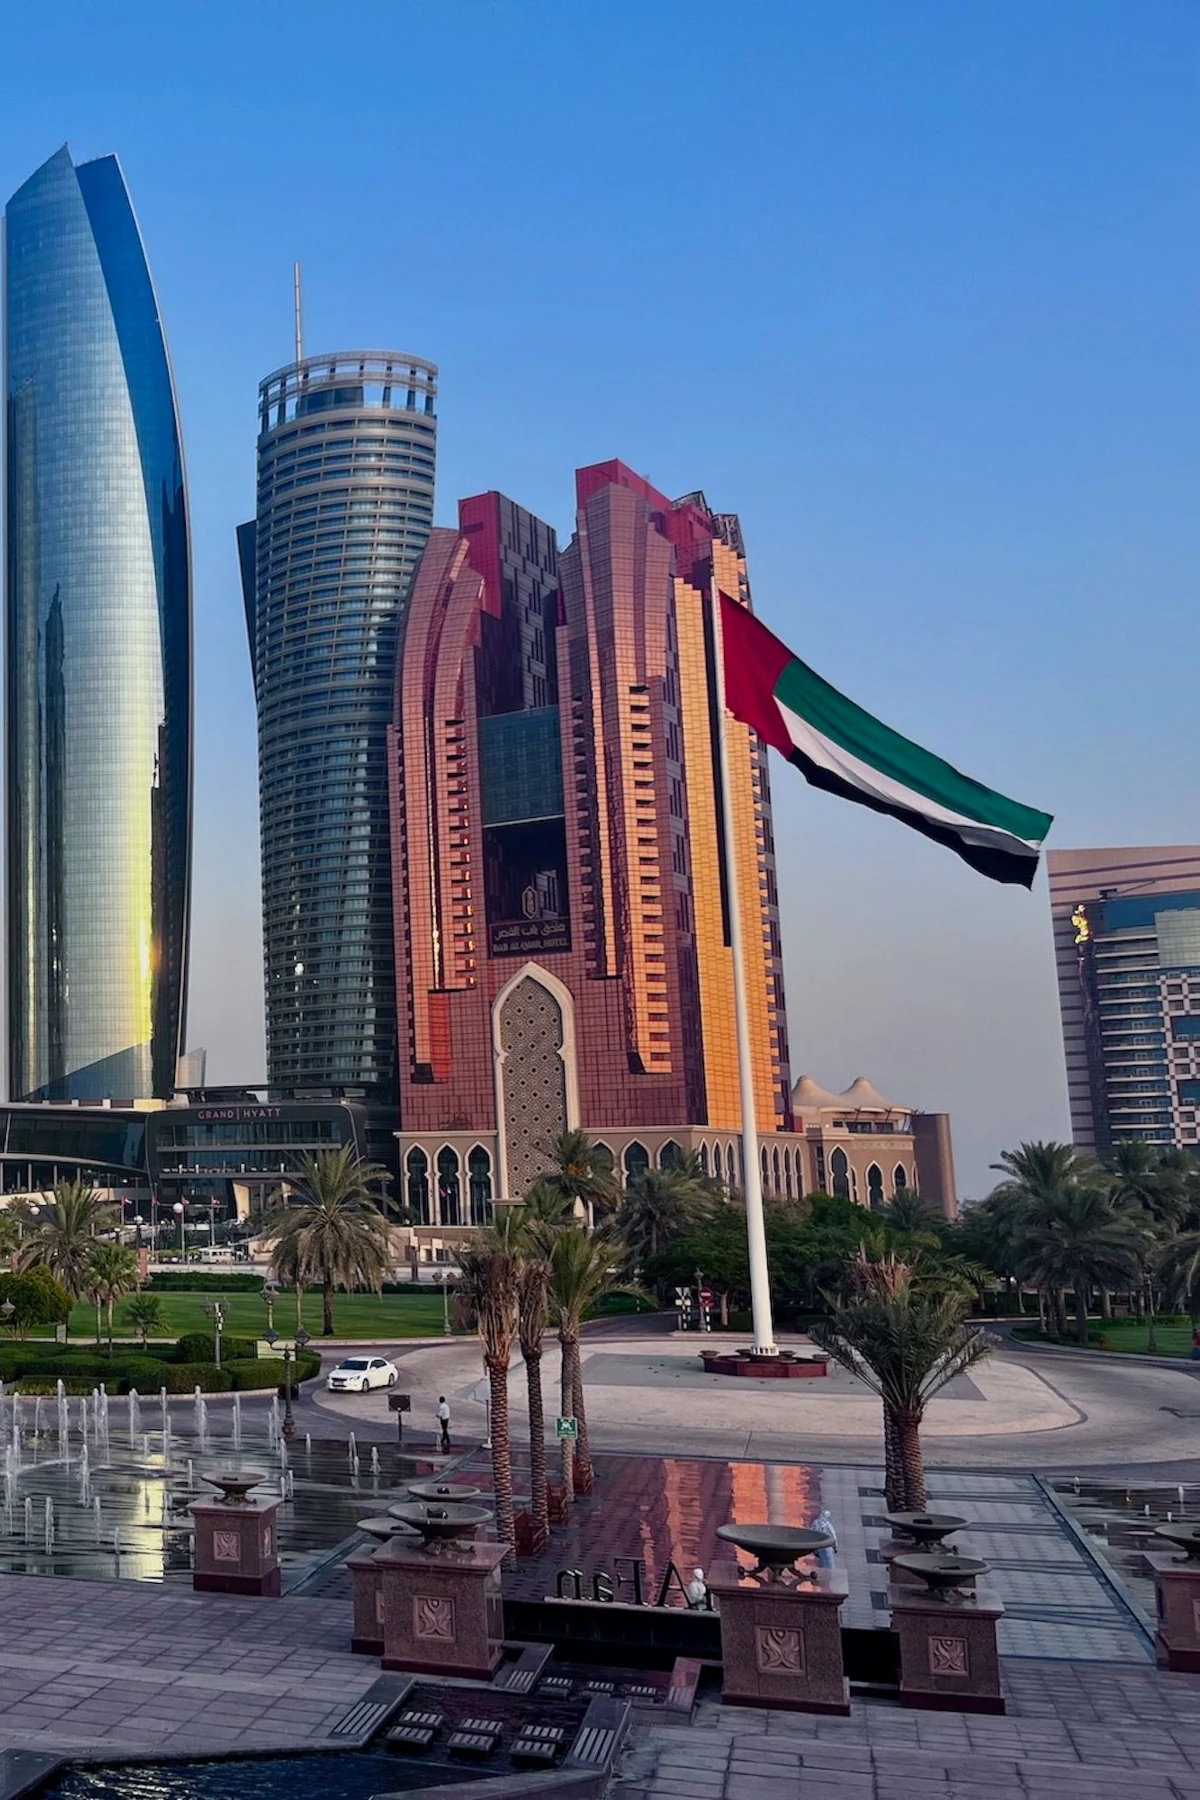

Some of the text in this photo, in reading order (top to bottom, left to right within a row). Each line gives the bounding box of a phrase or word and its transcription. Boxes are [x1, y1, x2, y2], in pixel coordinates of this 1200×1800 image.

[544, 937, 569, 948] HOTEL
[198, 1108, 281, 1120] GRAND HYATT
